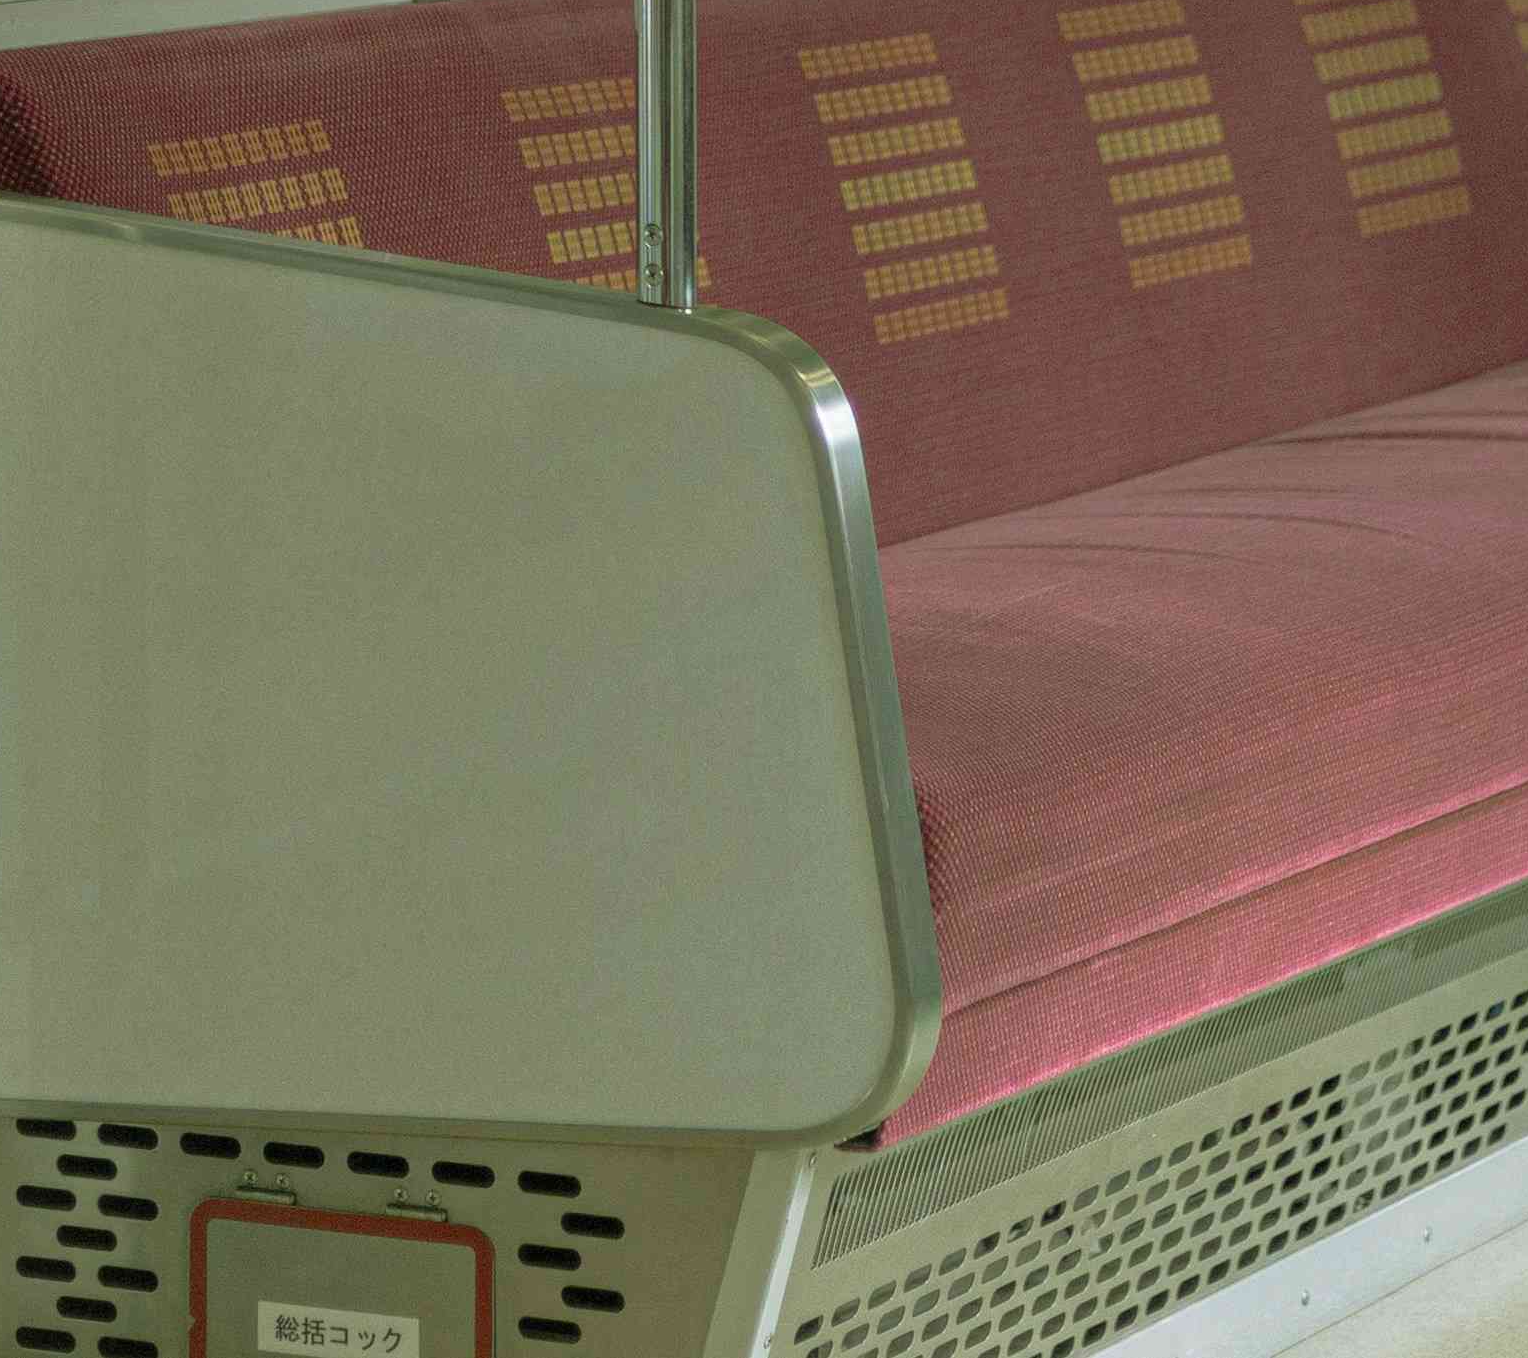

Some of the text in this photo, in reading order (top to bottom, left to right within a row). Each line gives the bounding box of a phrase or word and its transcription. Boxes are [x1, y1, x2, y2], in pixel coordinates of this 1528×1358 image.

[275, 1314, 403, 1353] 総括コック
